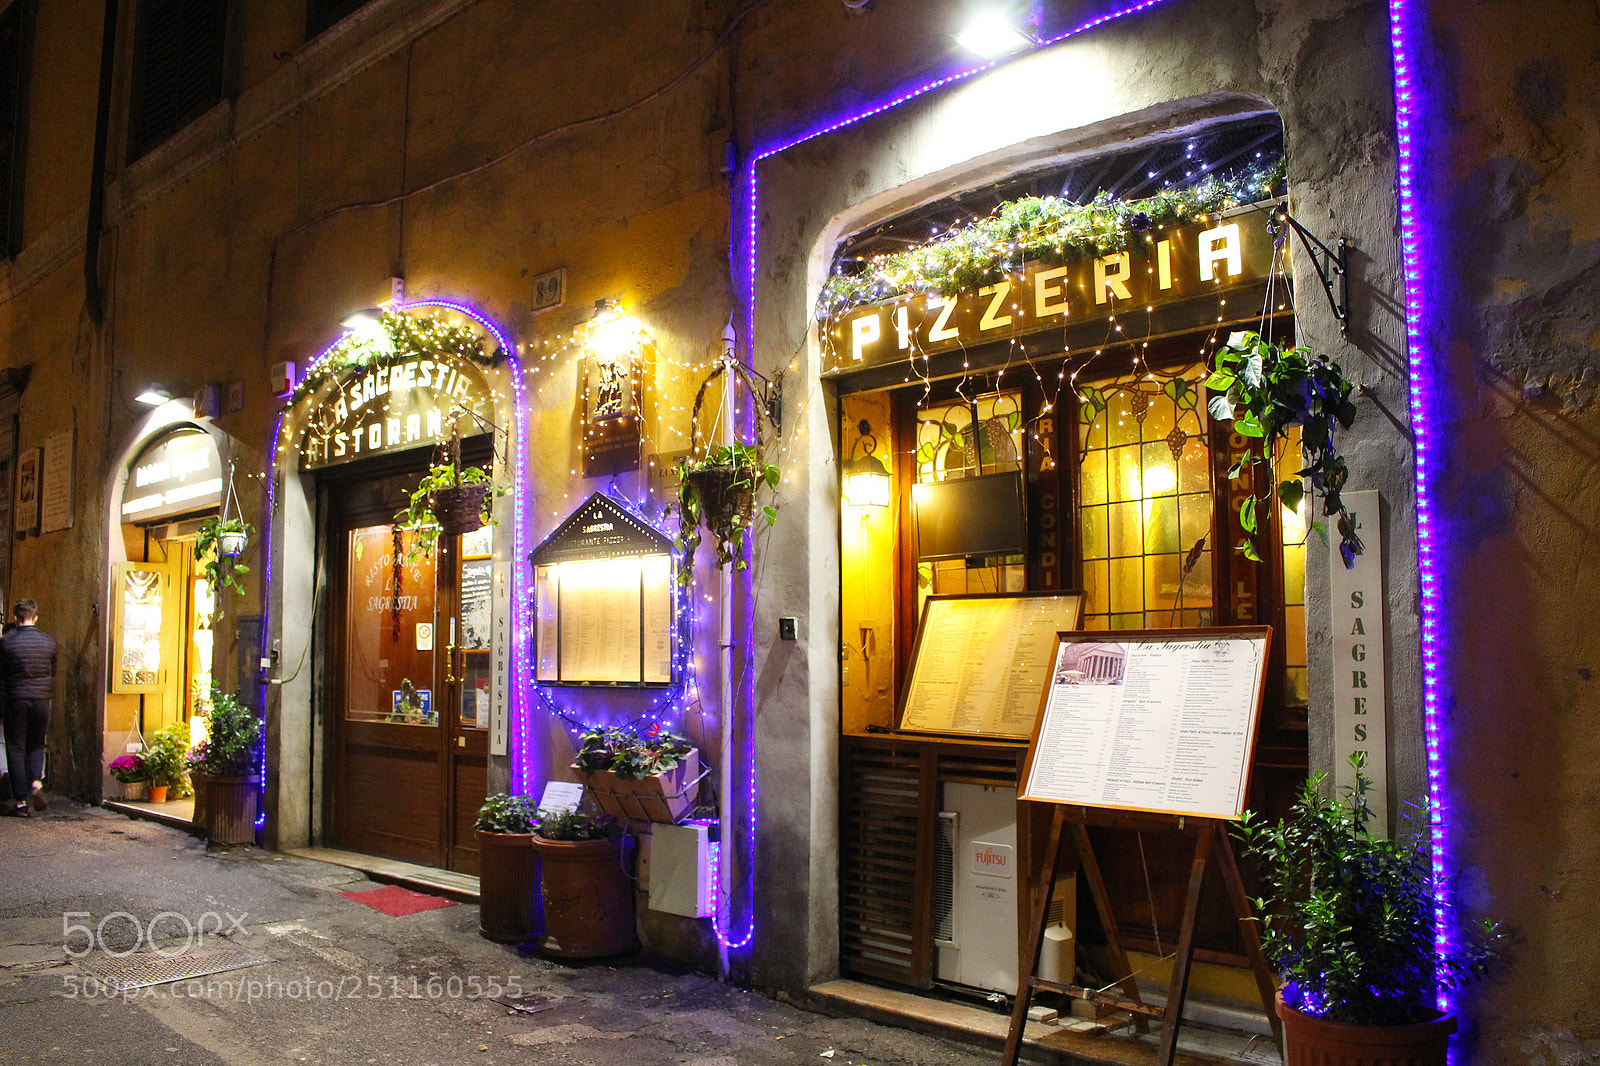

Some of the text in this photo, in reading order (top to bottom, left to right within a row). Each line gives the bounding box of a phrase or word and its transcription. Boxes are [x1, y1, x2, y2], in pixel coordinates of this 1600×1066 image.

[536, 277, 558, 306] 89
[851, 222, 1242, 360] PIZZERIA
[593, 510, 603, 520] LA
[366, 595, 418, 614] SAGRSTIA
[1156, 640, 1212, 654] Sagrestia
[496, 616, 504, 746] SAGRESTIA
[976, 848, 1007, 867] FUJITSU
